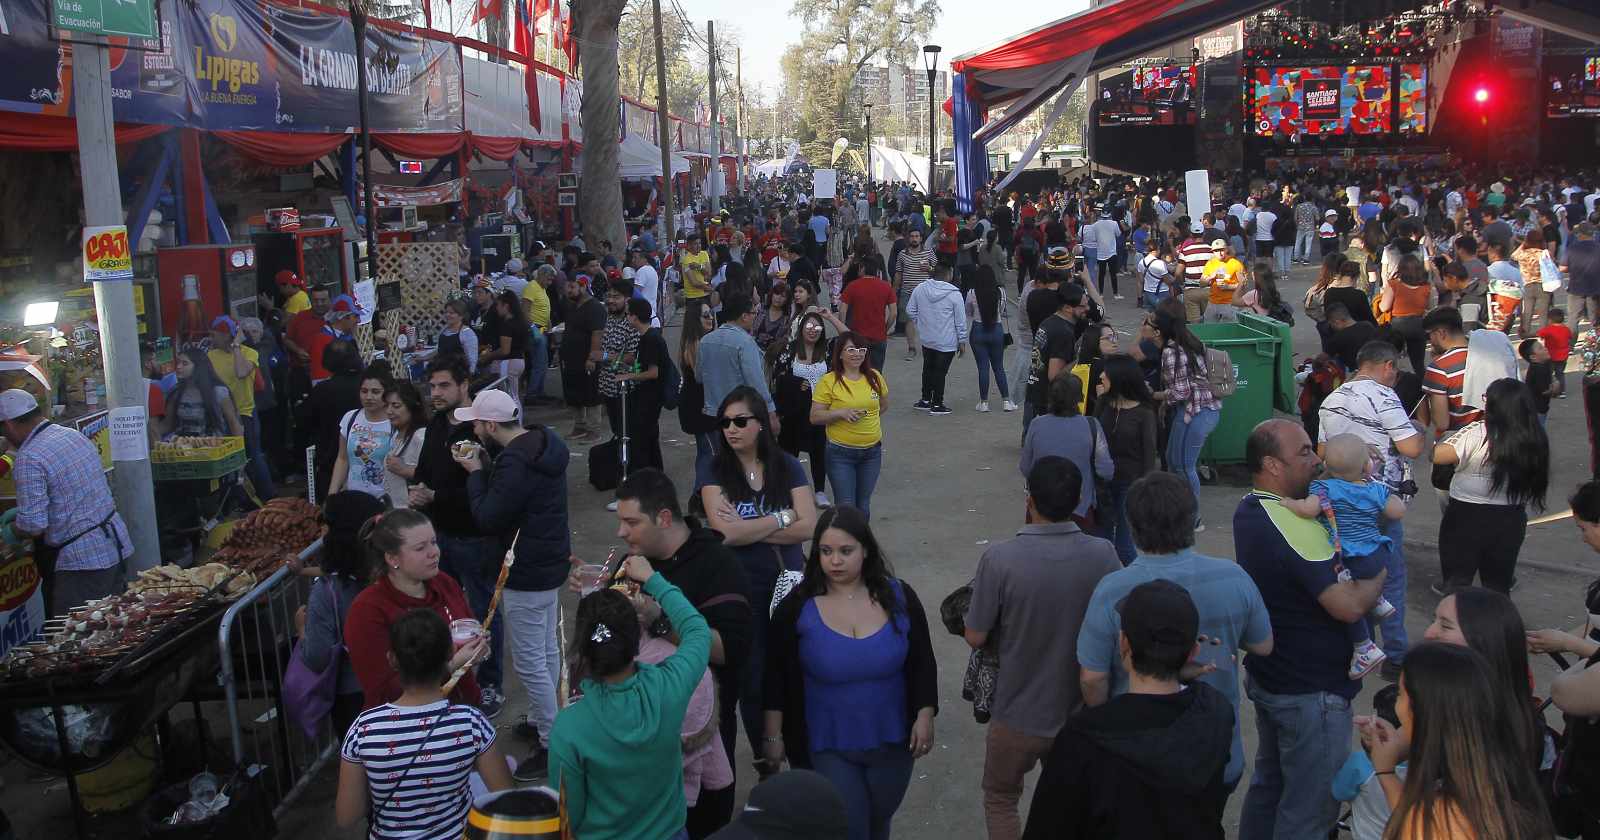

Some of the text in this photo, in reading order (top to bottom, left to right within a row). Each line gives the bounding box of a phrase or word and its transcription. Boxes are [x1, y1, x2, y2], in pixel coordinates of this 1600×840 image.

[72, 3, 82, 12] de
[59, 15, 101, 29] Evacuación
[143, 55, 174, 70] ESTRELLA
[195, 46, 259, 93] Lipigas
[300, 44, 318, 86] LA
[1306, 89, 1337, 99] SANTIAGO
[1307, 96, 1336, 104] CELEBRA
